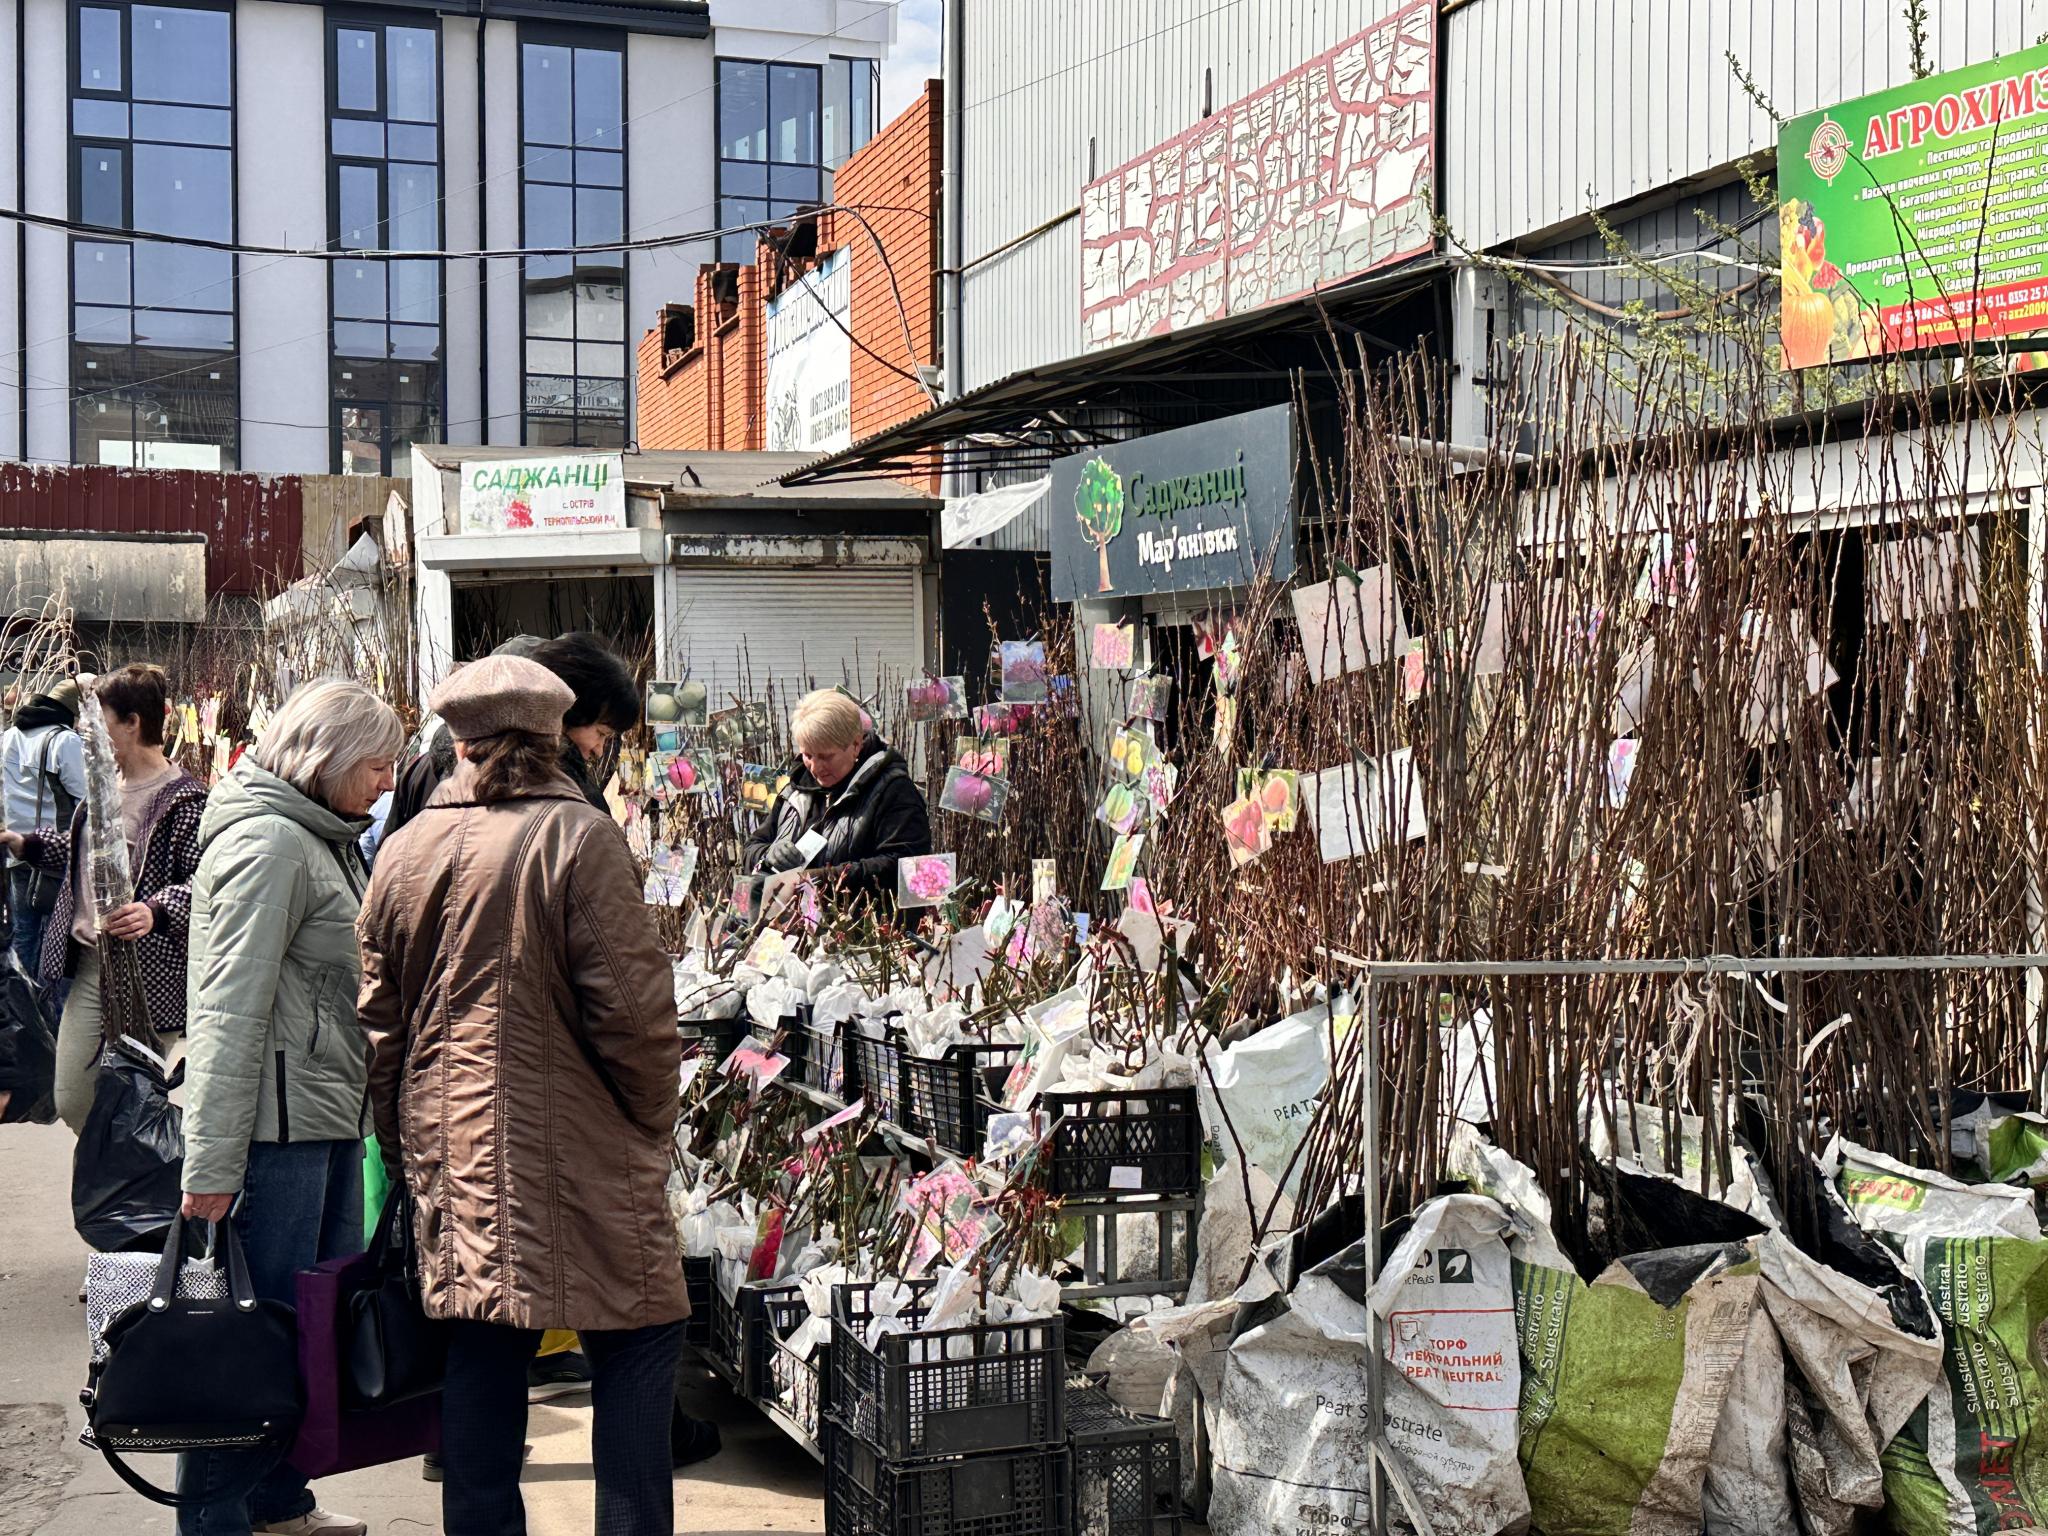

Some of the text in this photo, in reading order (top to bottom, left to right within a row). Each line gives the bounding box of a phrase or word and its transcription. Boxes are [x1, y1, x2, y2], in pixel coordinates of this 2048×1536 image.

[1980, 139, 1991, 152] та
[1953, 183, 1965, 196] та
[1914, 199, 1966, 224] Мінеральні
[1967, 198, 1979, 211] та
[1995, 250, 2007, 263] та
[473, 462, 608, 496] САДЖАНЦІ
[1128, 448, 1246, 520] Саджанці
[569, 499, 594, 509] ОСТРІВ
[1136, 521, 1238, 573] Мар'янівки
[1272, 1098, 1310, 1122] PEAT
[1539, 1288, 1567, 1372] Substrato
[1428, 1338, 1468, 1351] ТОРФ
[1404, 1349, 1503, 1367] НЕЙТРАЛЬНИЙ
[1406, 1366, 1503, 1383] PEAT NEUTRAL
[1952, 1345, 1982, 1414] Substrat
[1972, 1341, 2000, 1411] Sustrato
[1315, 1394, 1352, 1418] Peat
